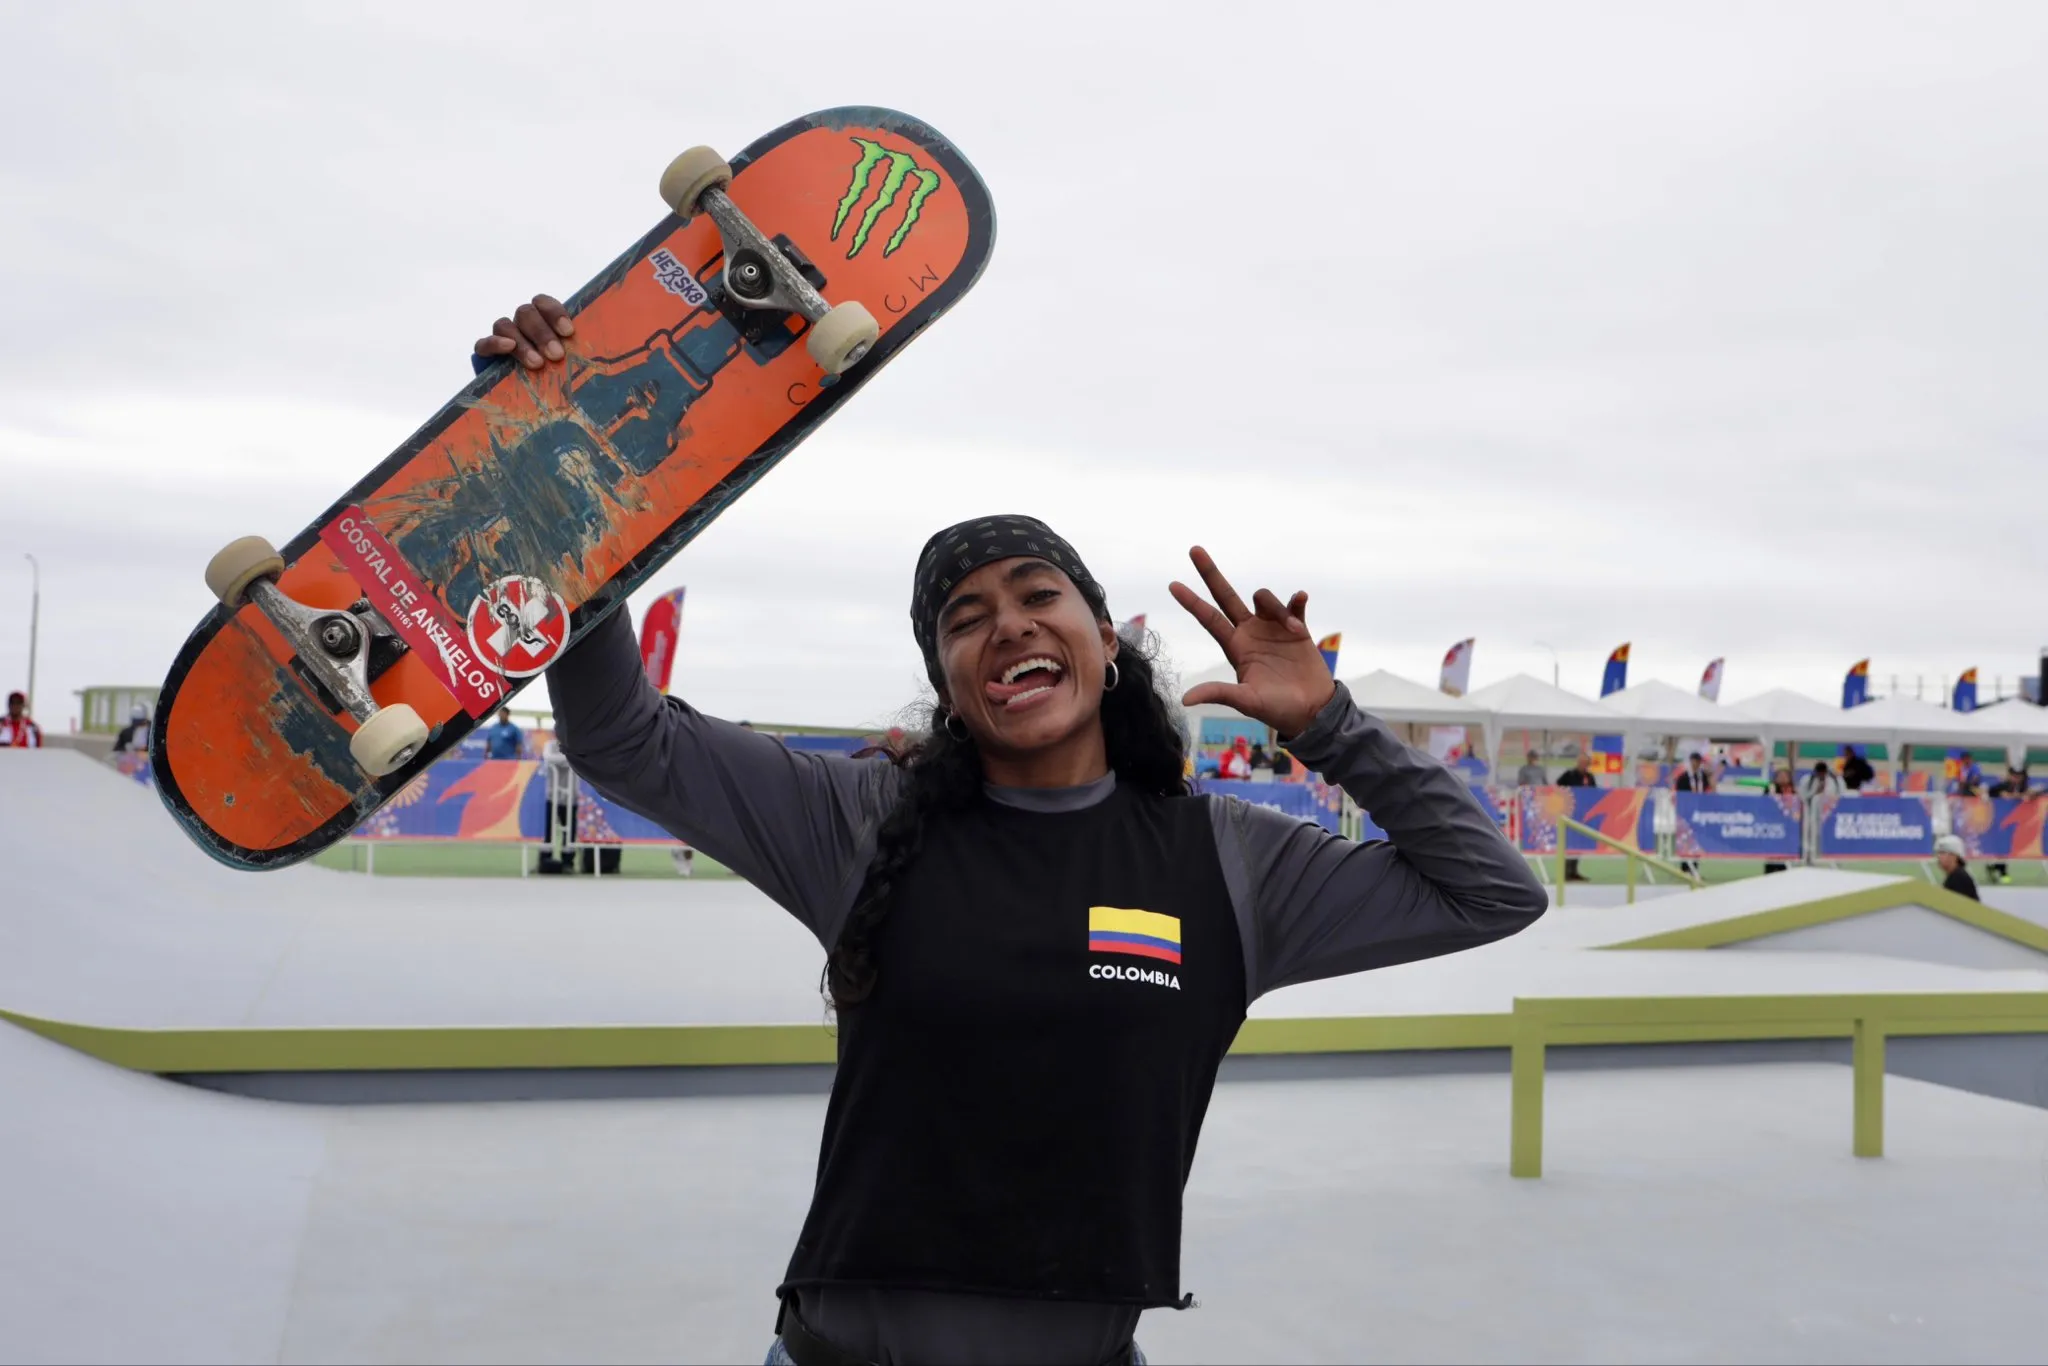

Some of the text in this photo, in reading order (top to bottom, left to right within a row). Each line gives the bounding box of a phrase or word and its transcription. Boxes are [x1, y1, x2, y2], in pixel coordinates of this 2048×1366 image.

[652, 250, 703, 304] HERSK8
[339, 517, 387, 585] COSTAL
[389, 579, 418, 609] DE
[410, 607, 495, 699] ANZUELOS
[390, 602, 413, 629] 111161
[1089, 964, 1181, 990] COLOMBIA
